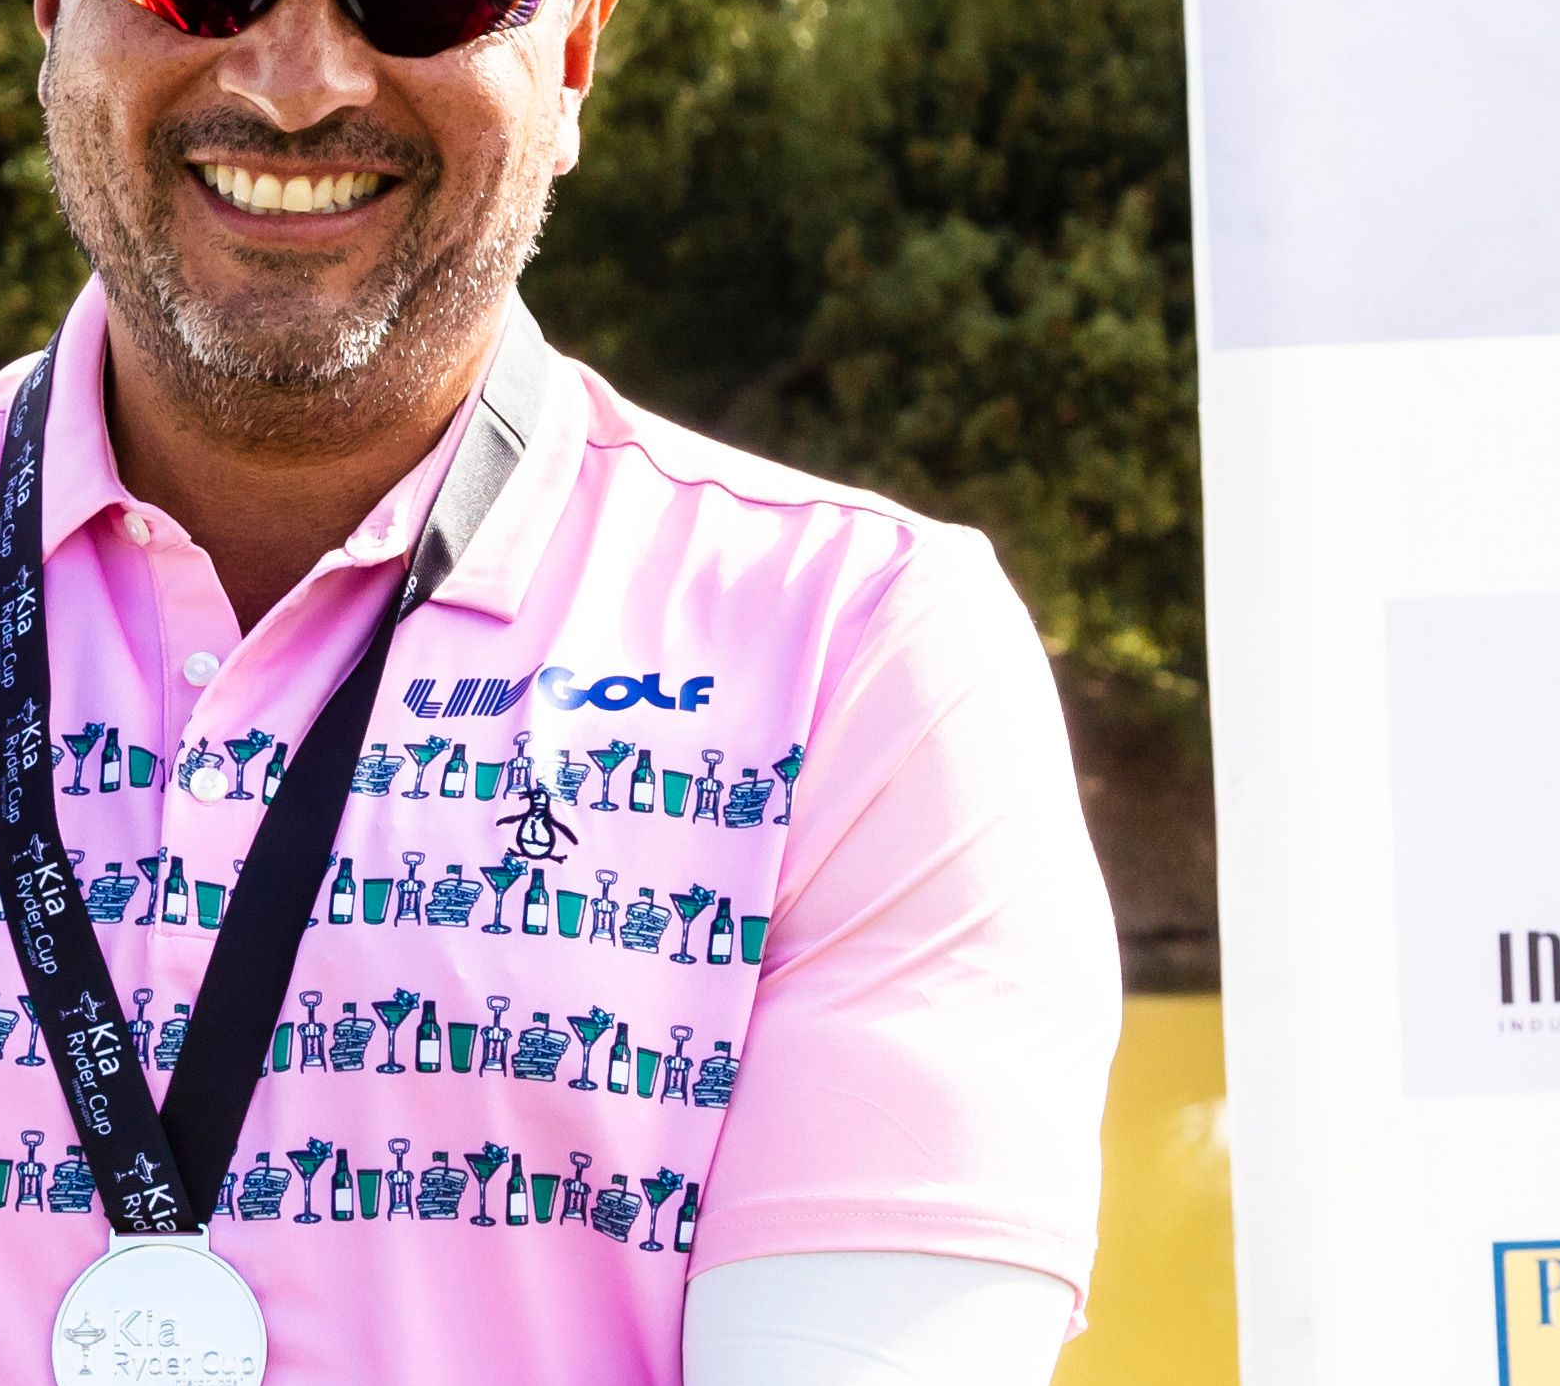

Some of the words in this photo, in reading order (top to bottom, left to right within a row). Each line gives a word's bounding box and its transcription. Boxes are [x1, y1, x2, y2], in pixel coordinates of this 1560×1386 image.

[3, 474, 18, 521] Ryder
[17, 460, 35, 507] Kia
[0, 523, 15, 558] Cup
[0, 600, 15, 649] Ryder
[17, 587, 36, 636] Kia
[0, 653, 17, 688] Cup
[402, 662, 544, 719] LIV
[538, 666, 715, 712] GOLF
[3, 733, 20, 783] Ryder
[21, 720, 42, 770] Kia
[6, 787, 22, 824] Cup
[34, 862, 66, 916] Kia
[16, 873, 44, 928] Ryder
[35, 934, 57, 974] Cup
[87, 1022, 121, 1076] Kia
[67, 1031, 98, 1088] Ryder
[89, 1094, 112, 1135] Cup
[143, 1184, 178, 1232] Kia
[114, 1310, 180, 1347] Kia
[114, 1351, 192, 1381] Ryder
[202, 1351, 255, 1381] Cup
